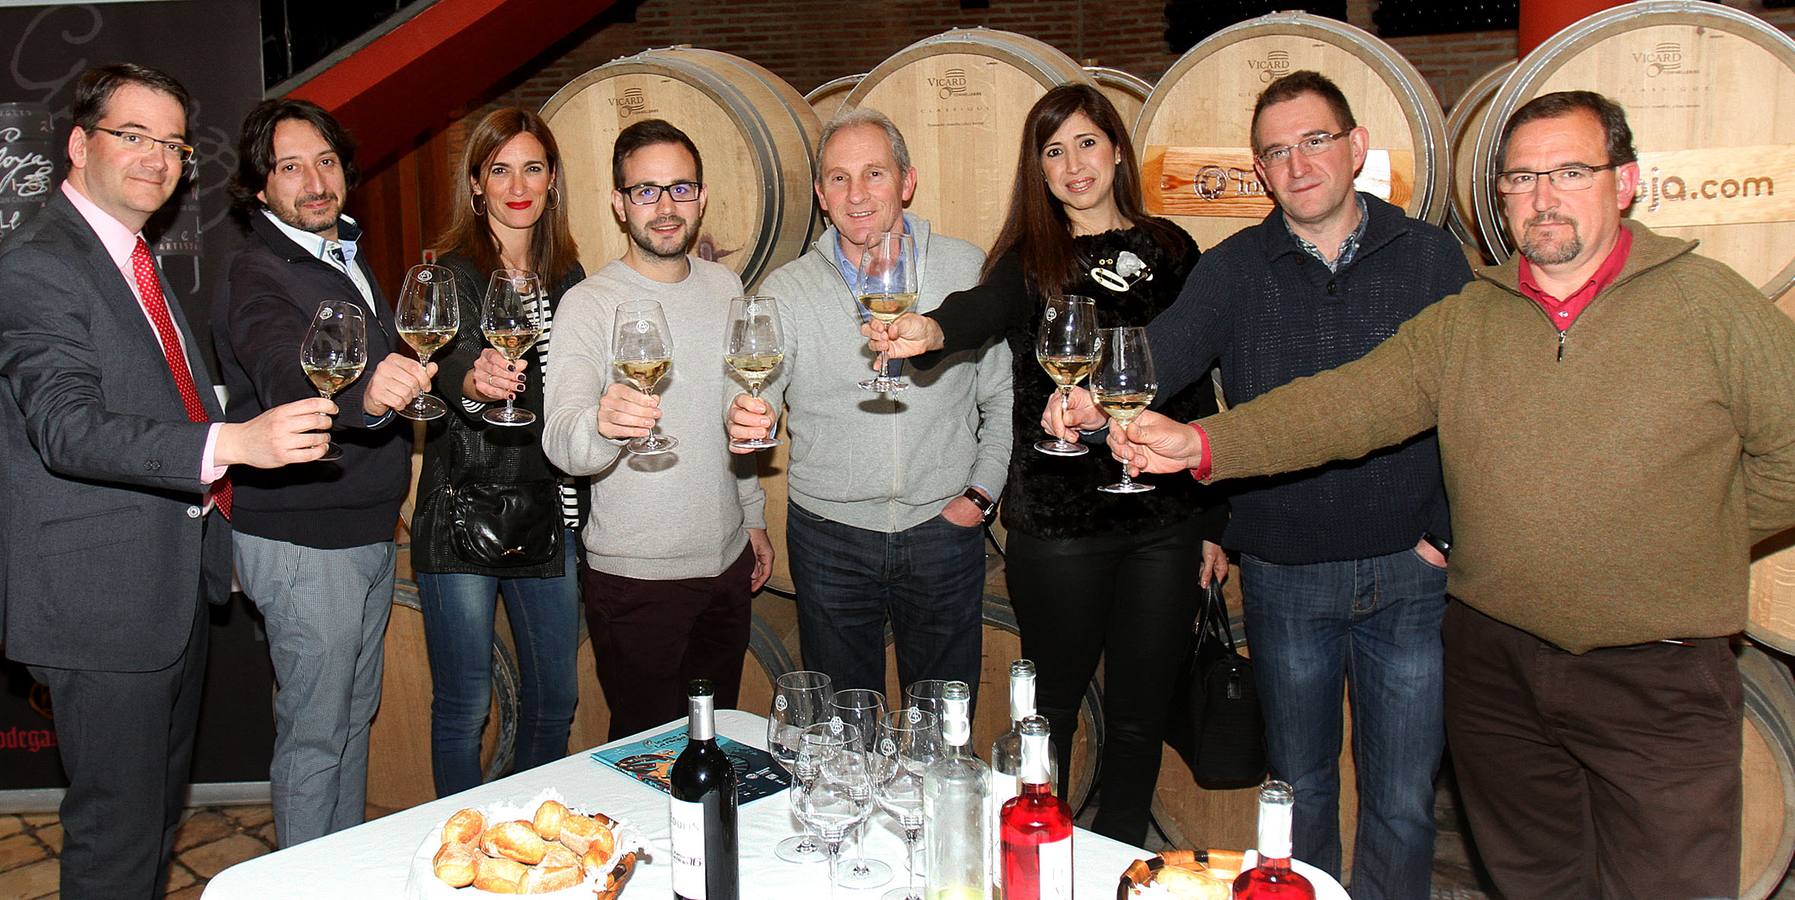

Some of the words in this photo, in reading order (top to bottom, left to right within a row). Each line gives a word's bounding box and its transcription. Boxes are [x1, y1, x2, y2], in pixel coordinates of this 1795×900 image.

[1631, 52, 1682, 63] VICARD
[1247, 60, 1290, 69] VICARD
[927, 77, 967, 87] VICARD
[608, 96, 645, 106] VICARD
